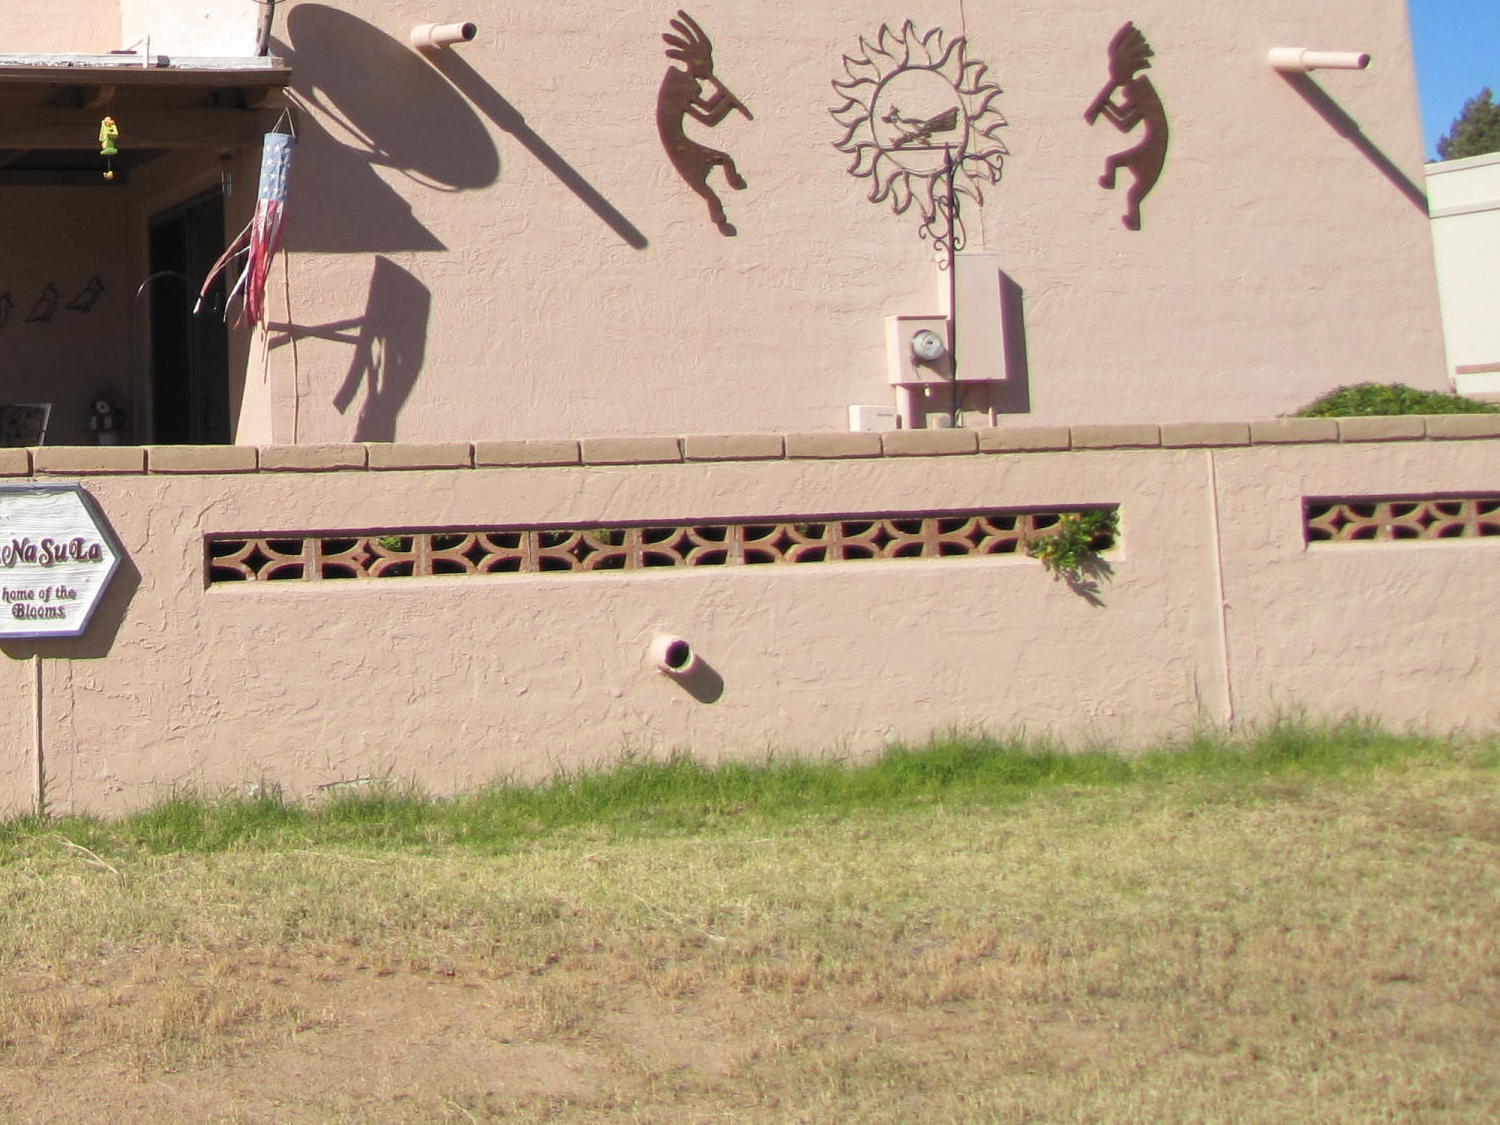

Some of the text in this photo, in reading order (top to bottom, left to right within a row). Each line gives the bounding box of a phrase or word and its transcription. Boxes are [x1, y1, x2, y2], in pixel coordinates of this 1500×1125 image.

[2, 585, 77, 602] home of the
[12, 603, 65, 618] Blooms
